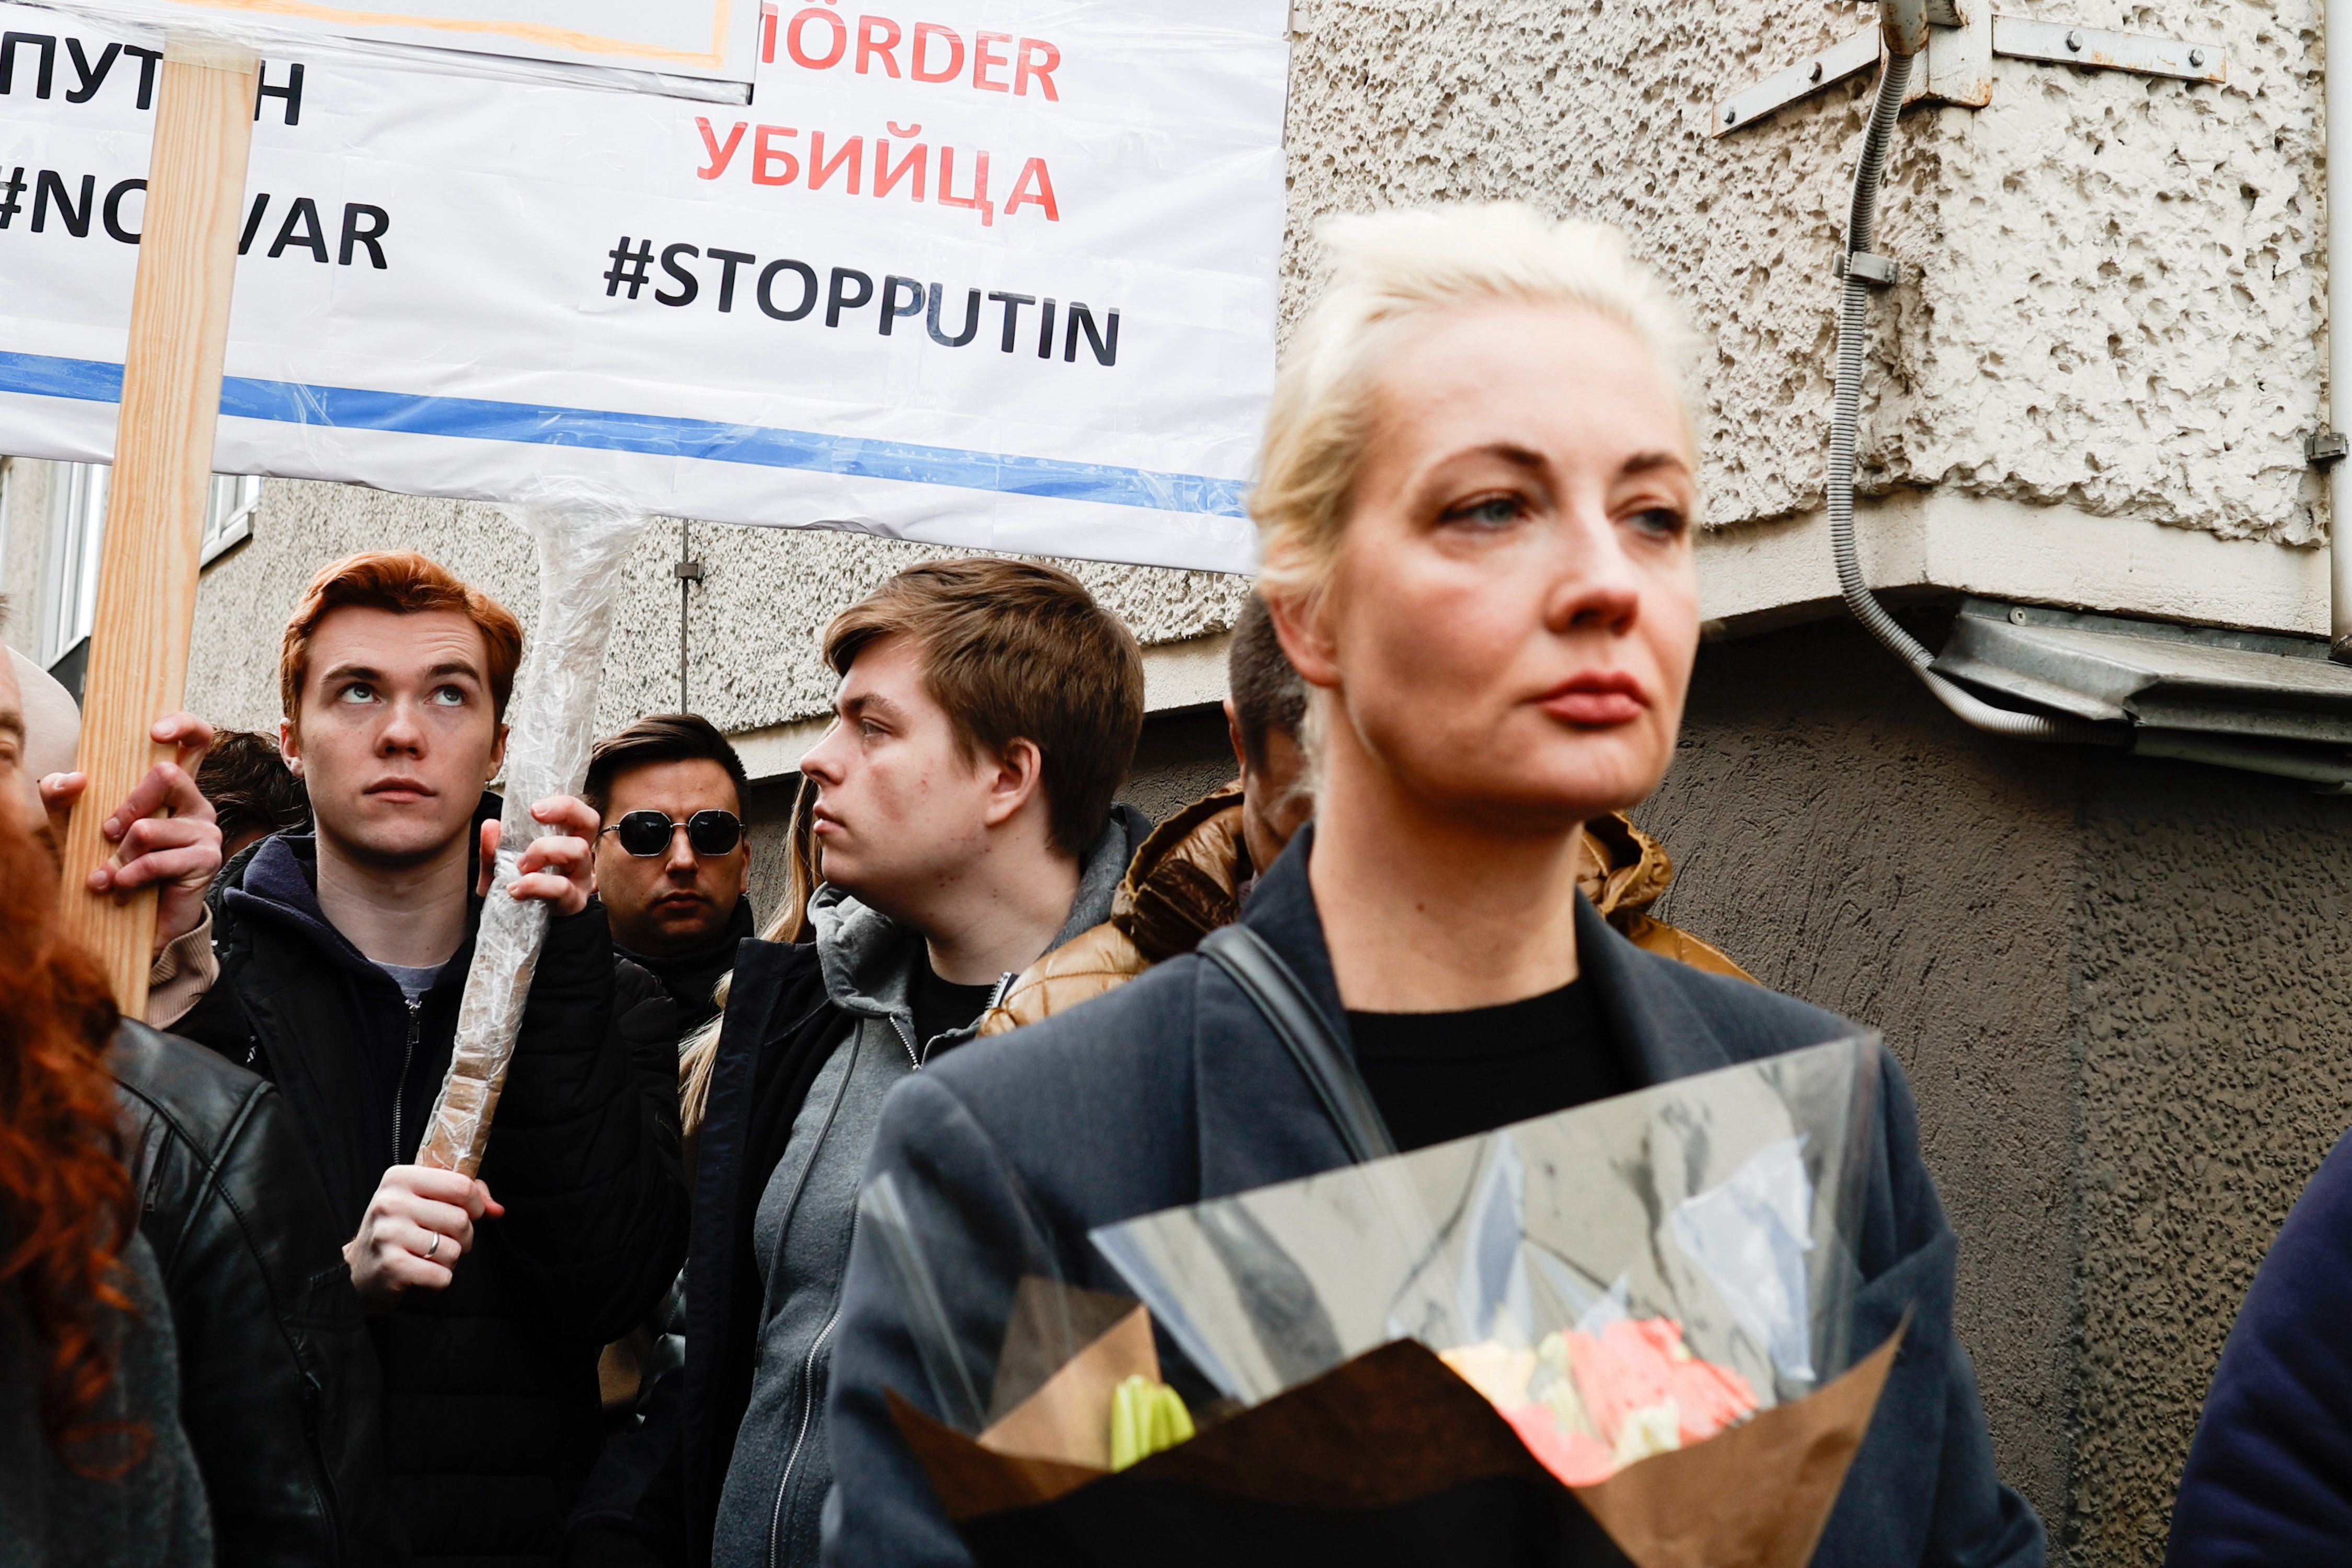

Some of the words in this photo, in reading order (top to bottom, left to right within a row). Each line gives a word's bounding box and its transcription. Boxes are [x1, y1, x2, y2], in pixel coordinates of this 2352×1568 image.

[0, 31, 305, 126] ПУТН
[761, 0, 1060, 102] ÖRDER
[695, 117, 1059, 227] УБИЙЦА
[604, 236, 1120, 367] #STOPPUTIN
